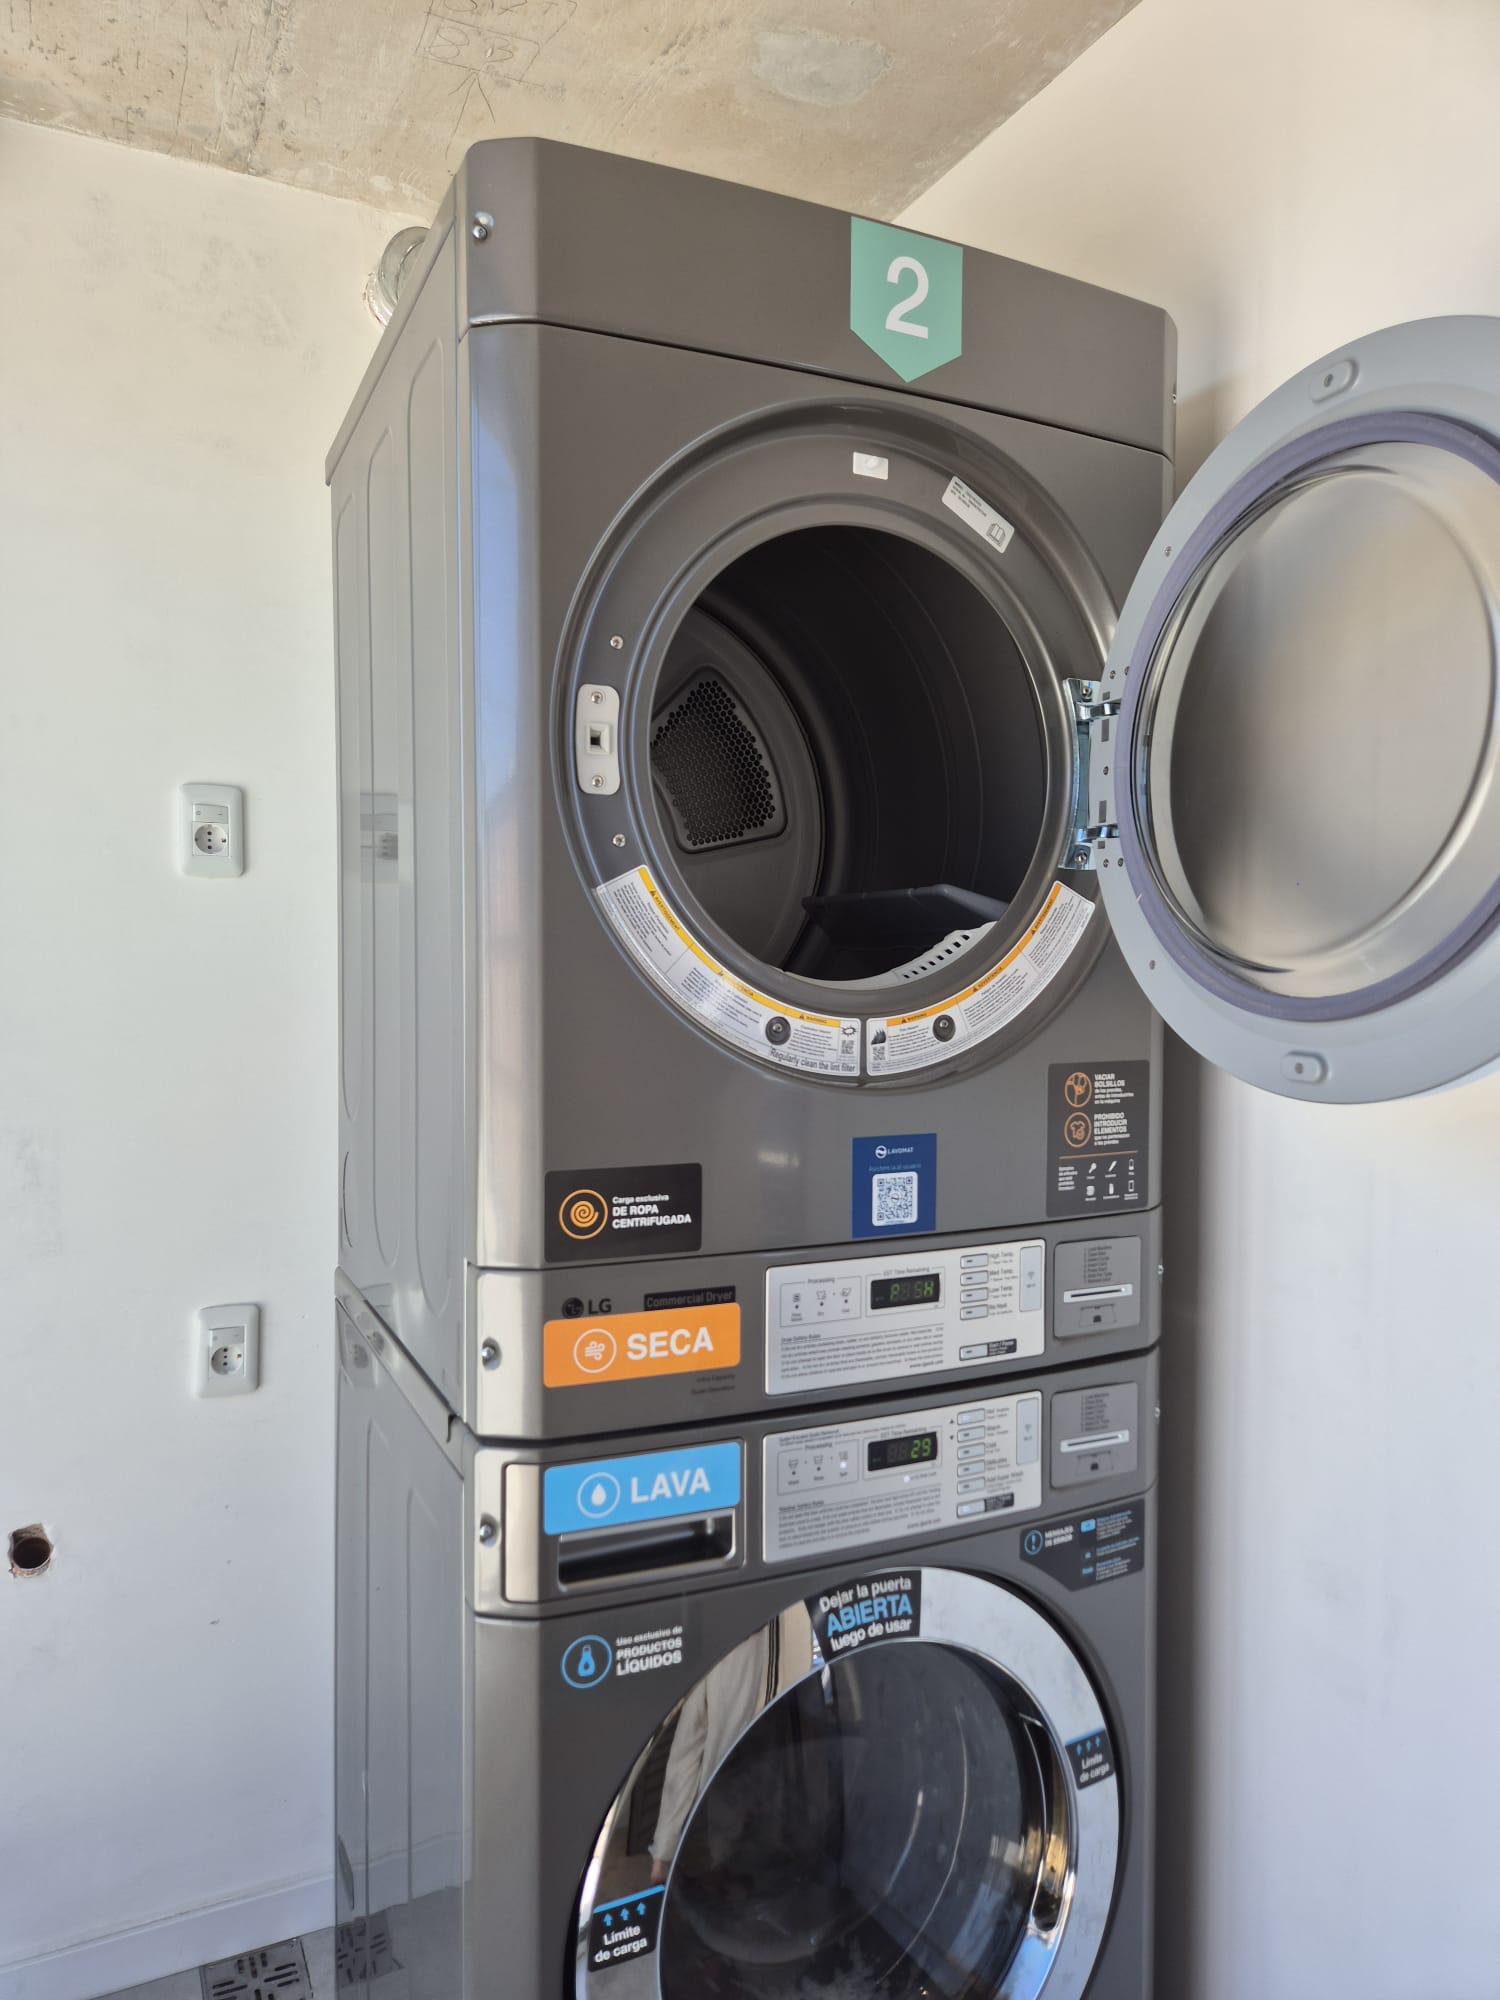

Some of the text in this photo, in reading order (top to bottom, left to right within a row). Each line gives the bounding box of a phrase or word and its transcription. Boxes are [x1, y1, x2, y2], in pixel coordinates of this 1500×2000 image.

[885, 256, 929, 339] 2
[770, 1047, 799, 1067] Regularly
[800, 1058, 818, 1069] clean
[819, 1061, 829, 1071] the
[841, 1062, 856, 1072] filter
[1094, 1073, 1116, 1081] VACIAR
[1094, 1080, 1125, 1088] BOLSILLOS
[1093, 1119, 1128, 1127] INTRODUCIR
[1094, 1112, 1125, 1120] PROHIBIDO
[1094, 1126, 1127, 1135] ELEMENTOS
[612, 1193, 670, 1205] Carga exclusiva
[612, 1204, 659, 1217] DE ROPA
[612, 1213, 692, 1229] CENTRIFUGADA
[588, 1298, 613, 1315] LG
[646, 1290, 733, 1307] Commercial Dryer
[626, 1326, 714, 1361] SECA
[910, 1438, 932, 1459] 29
[630, 1467, 711, 1504] LAVA
[819, 1576, 912, 1613] Dejar la puerta
[827, 1593, 913, 1638] ABIERTA
[616, 1625, 683, 1646] Uso exclusivo de
[830, 1618, 912, 1652] luego de usar
[616, 1636, 683, 1660] PRODUCTOS
[616, 1649, 683, 1676] LÍQUIDOS
[1079, 1762, 1110, 1783] de carga
[603, 1925, 641, 1946] Límite
[594, 1937, 648, 1963] de carga
